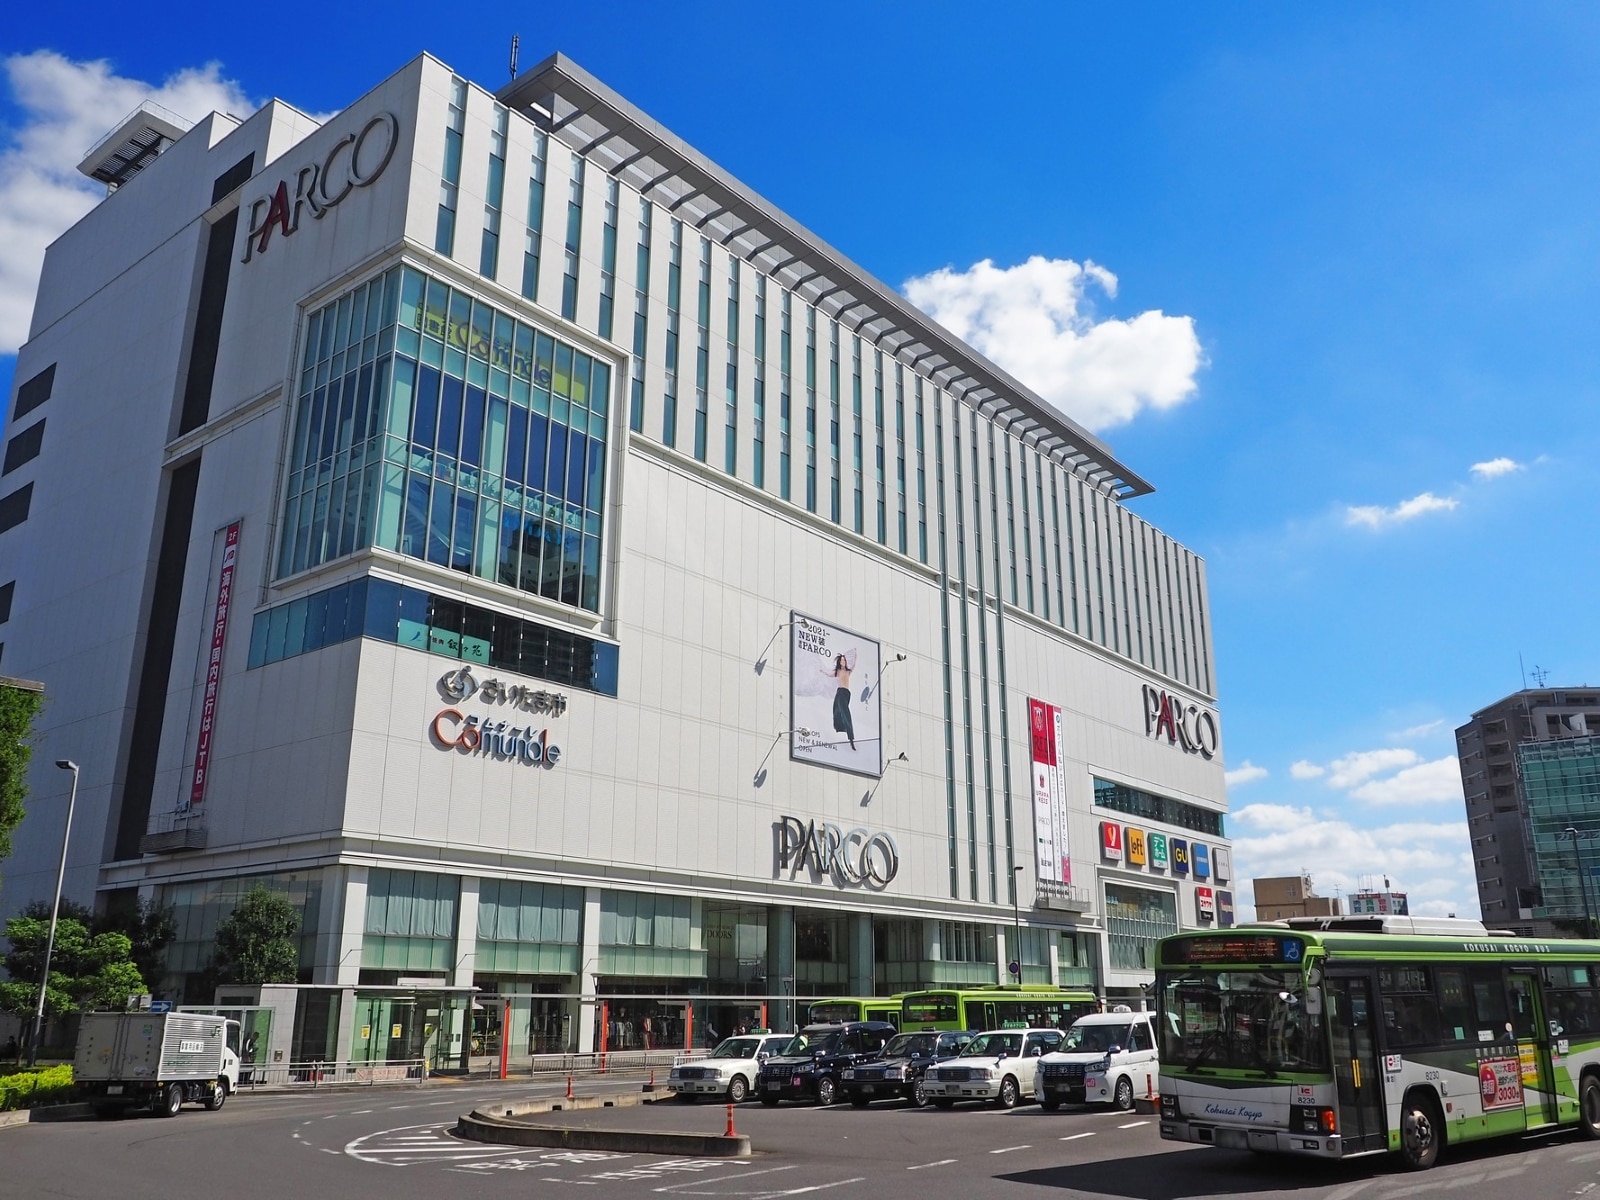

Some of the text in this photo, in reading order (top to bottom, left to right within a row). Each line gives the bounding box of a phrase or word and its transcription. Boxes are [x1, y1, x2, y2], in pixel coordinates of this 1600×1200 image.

[240, 111, 398, 264] PARCO
[228, 531, 237, 541] 2F
[803, 642, 832, 658] PARCO
[196, 571, 232, 785] 海外旅行・国内旅行はJTB
[1142, 683, 1219, 759] PARCO
[434, 708, 562, 765] Comunale
[779, 815, 899, 891] PARCO
[1175, 847, 1188, 864] GU
[1463, 943, 1551, 953] KOKUSAI KOGYO BUS
[1425, 1070, 1440, 1081] 8230
[1204, 1103, 1263, 1121] Kokusai Kogyo
